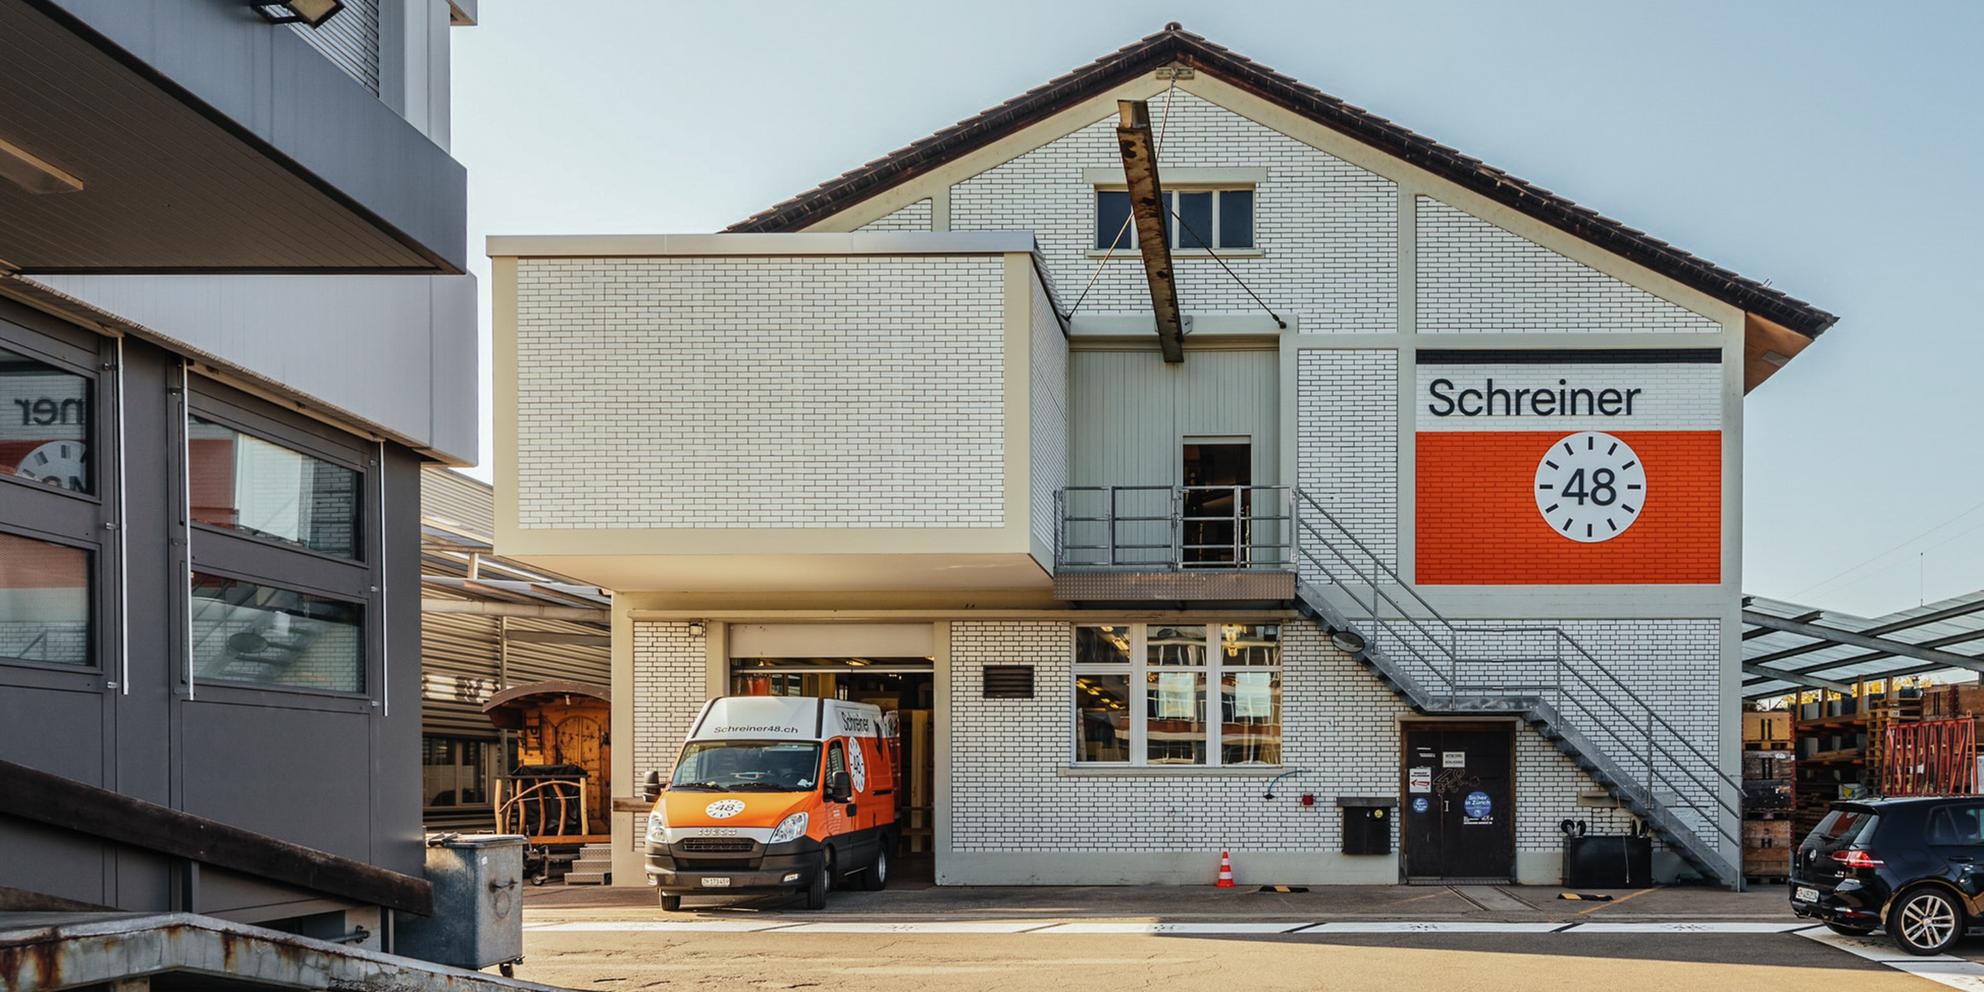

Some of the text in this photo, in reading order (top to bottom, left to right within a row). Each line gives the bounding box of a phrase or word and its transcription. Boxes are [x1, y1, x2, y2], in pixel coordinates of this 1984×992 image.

[1429, 378, 1641, 417] Schreiner
[1561, 467, 1617, 506] 48
[713, 724, 798, 734] Schreiner48.ch
[715, 803, 735, 811] 48
